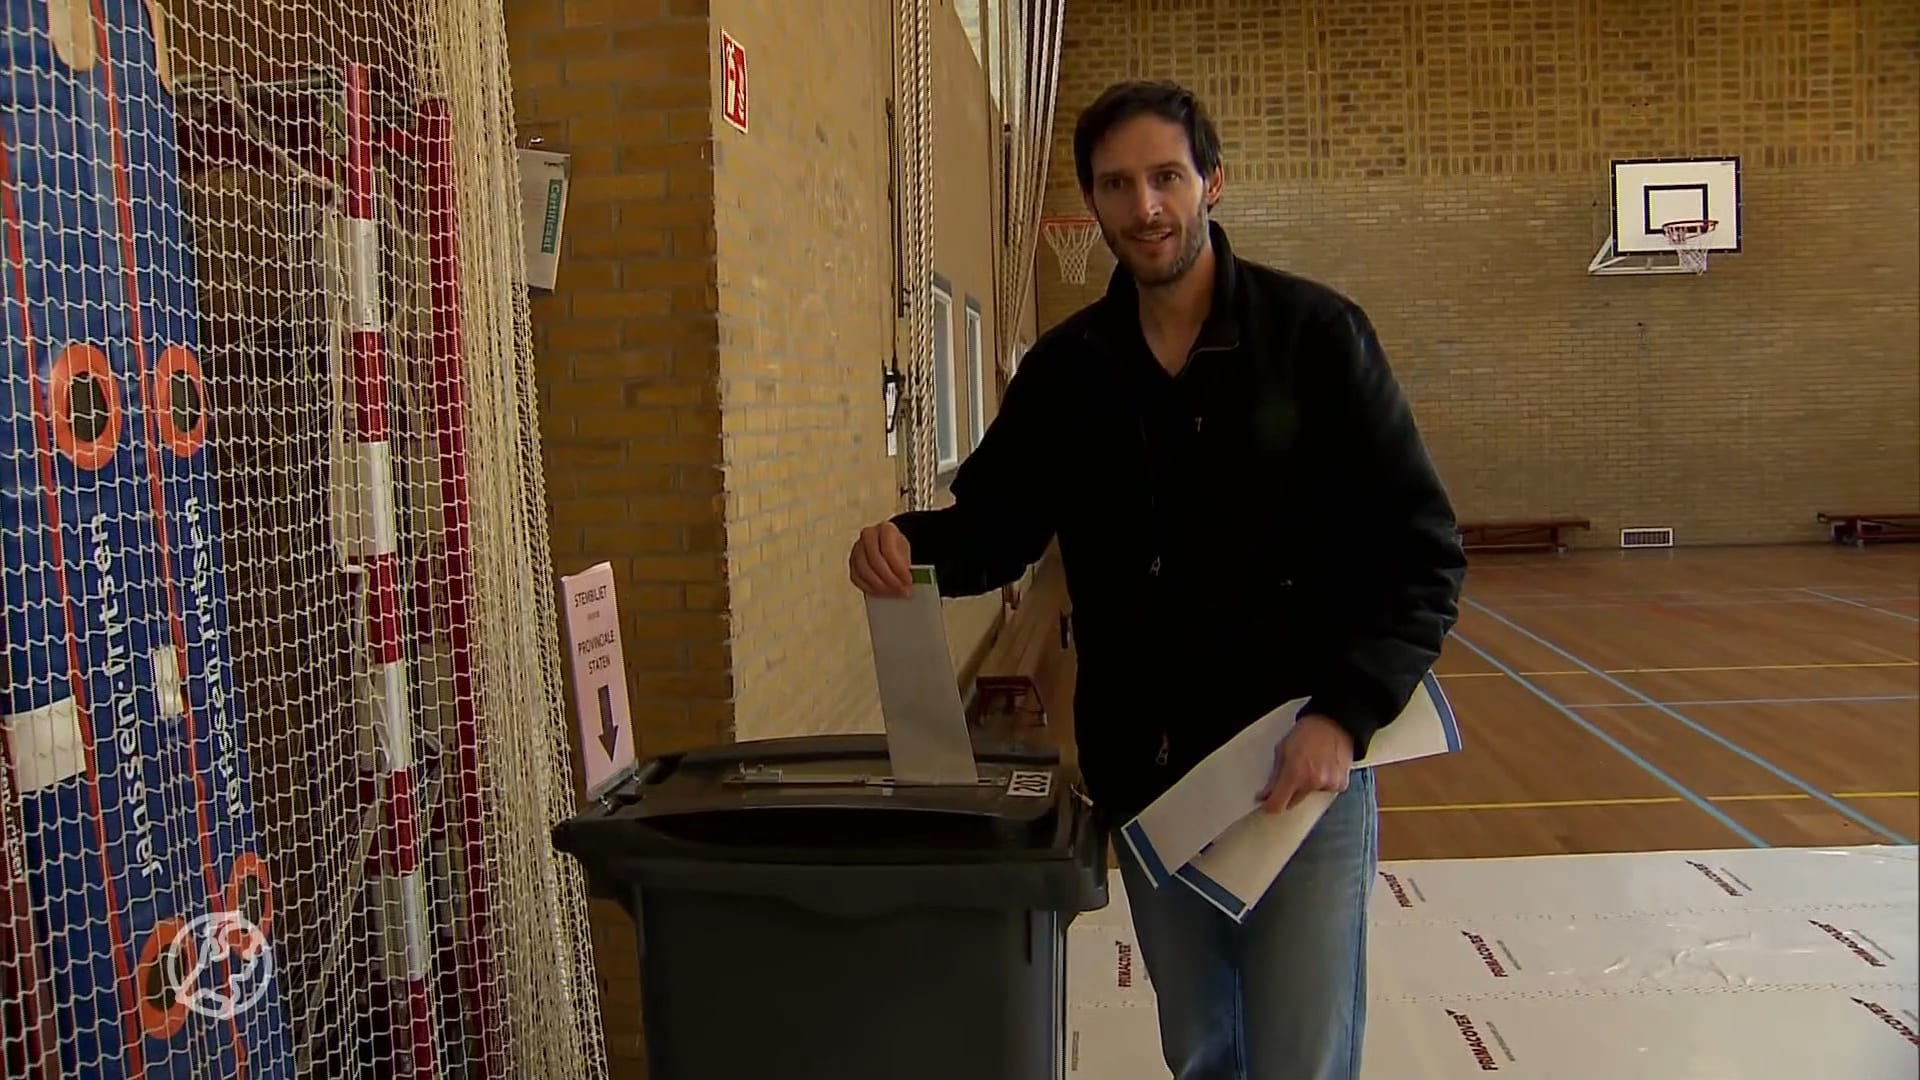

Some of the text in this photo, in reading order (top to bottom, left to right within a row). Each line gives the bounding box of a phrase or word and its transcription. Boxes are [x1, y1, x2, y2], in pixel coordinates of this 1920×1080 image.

[588, 655, 611, 675] STATEN
[1013, 773, 1048, 793] 203
[1467, 934, 1508, 978] PRIMACOVER
[1453, 1014, 1499, 1071] PRIMACOVER
